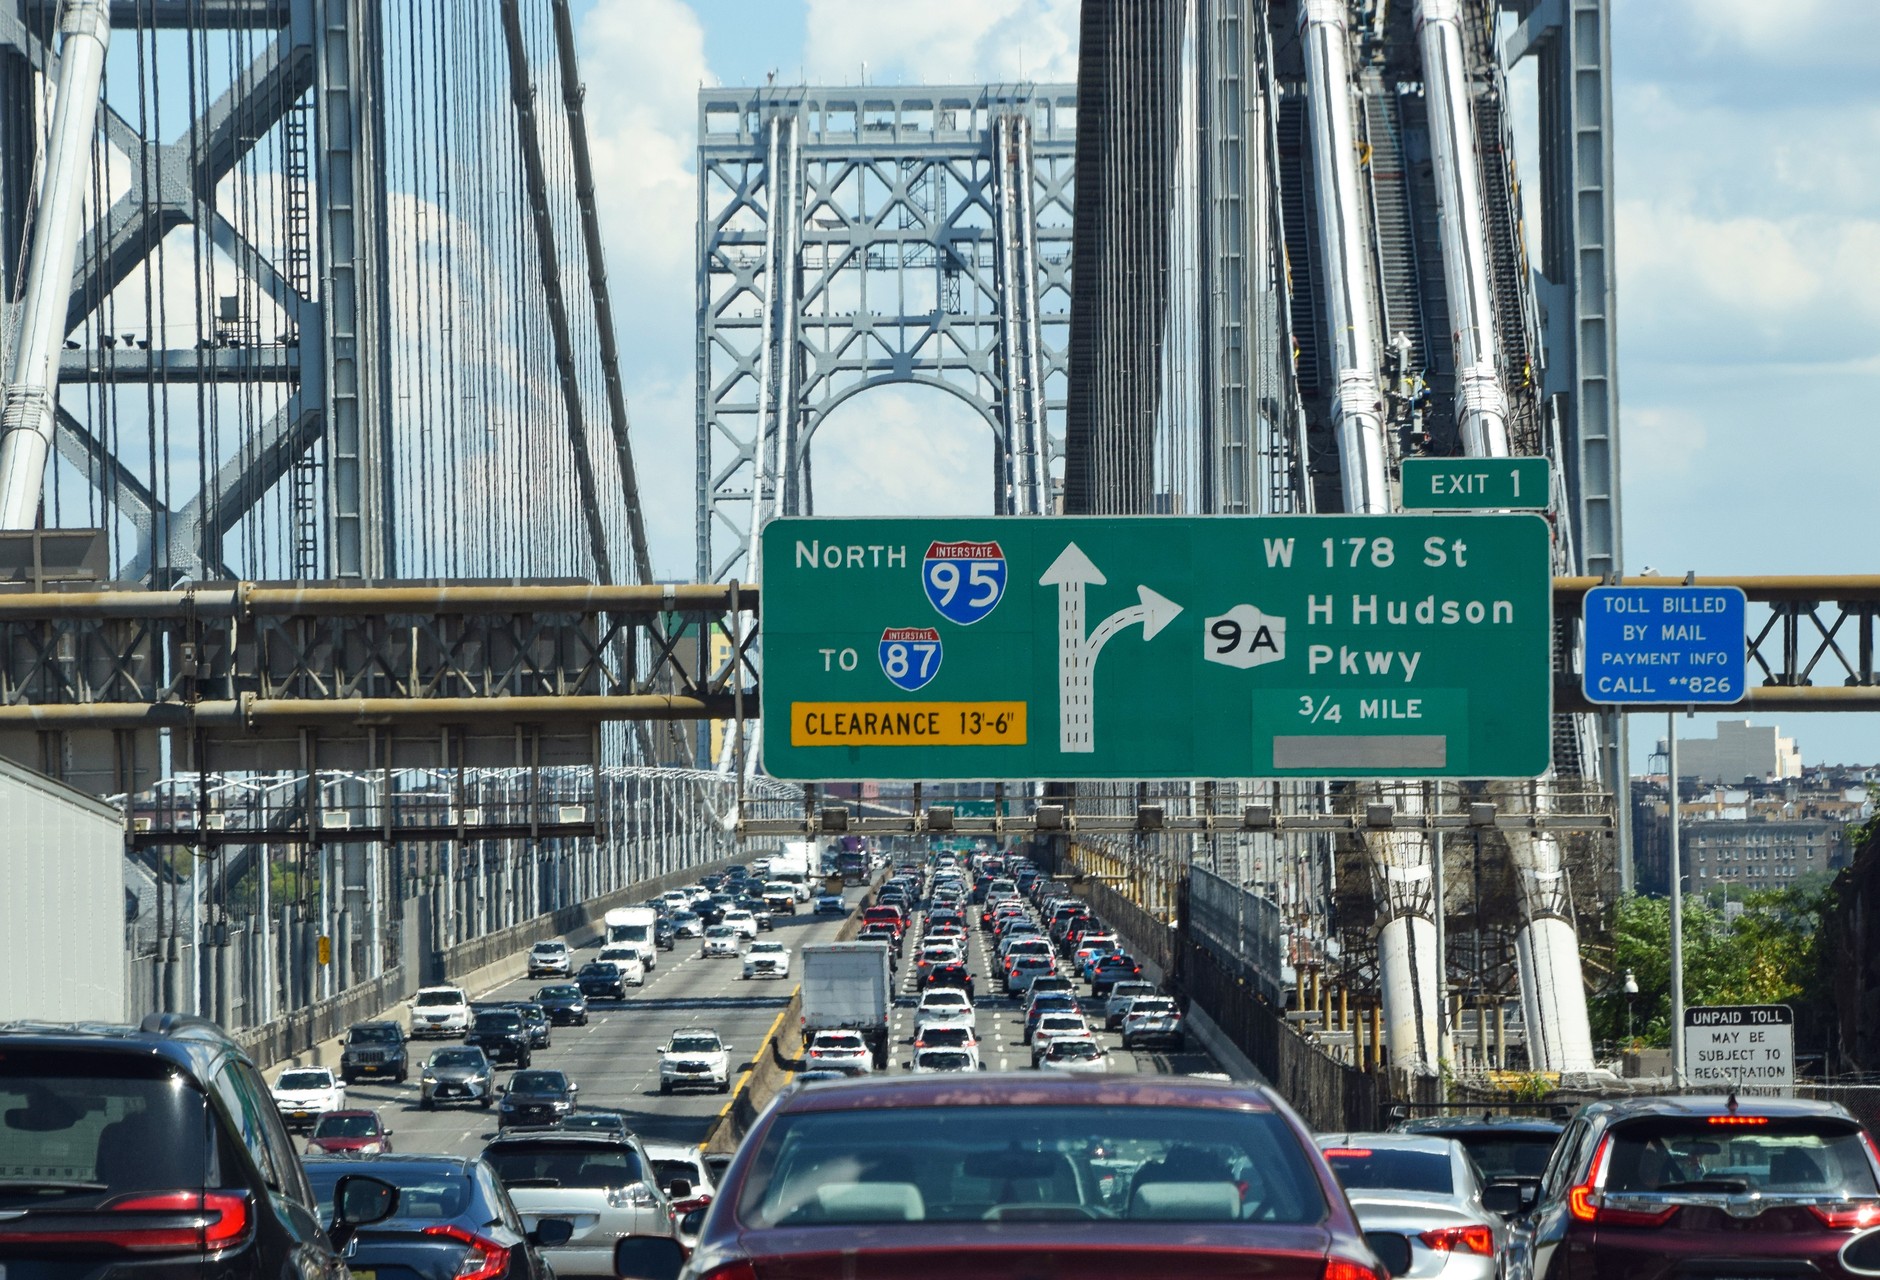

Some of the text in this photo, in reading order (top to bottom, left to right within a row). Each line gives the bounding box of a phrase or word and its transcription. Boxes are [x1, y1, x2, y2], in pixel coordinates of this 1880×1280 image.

[1431, 469, 1520, 498] EXIT 1
[795, 539, 906, 569] NORTH
[934, 546, 994, 558] INTERSTATE
[1263, 536, 1467, 568] W 178 St
[930, 562, 999, 608] 95
[1307, 594, 1513, 625] H Hudson
[1603, 596, 1727, 614] TOLL BILLED
[888, 631, 933, 641] INTERSTATE
[1210, 619, 1280, 655] 9A
[1623, 624, 1707, 641] BY MAIL
[818, 647, 858, 672] TO
[885, 644, 937, 679] 87
[1308, 644, 1422, 683] Pkwy
[1601, 651, 1728, 666] PAYMENT INFO
[1598, 676, 1656, 694] CALL
[1298, 695, 1422, 724] 3/4 MILE
[805, 712, 940, 736] CLEARANCE
[1692, 1010, 1783, 1025] UNPAID TOLL
[1711, 1031, 1765, 1044] MAY BE
[1698, 1048, 1781, 1062] SUBJECT TO
